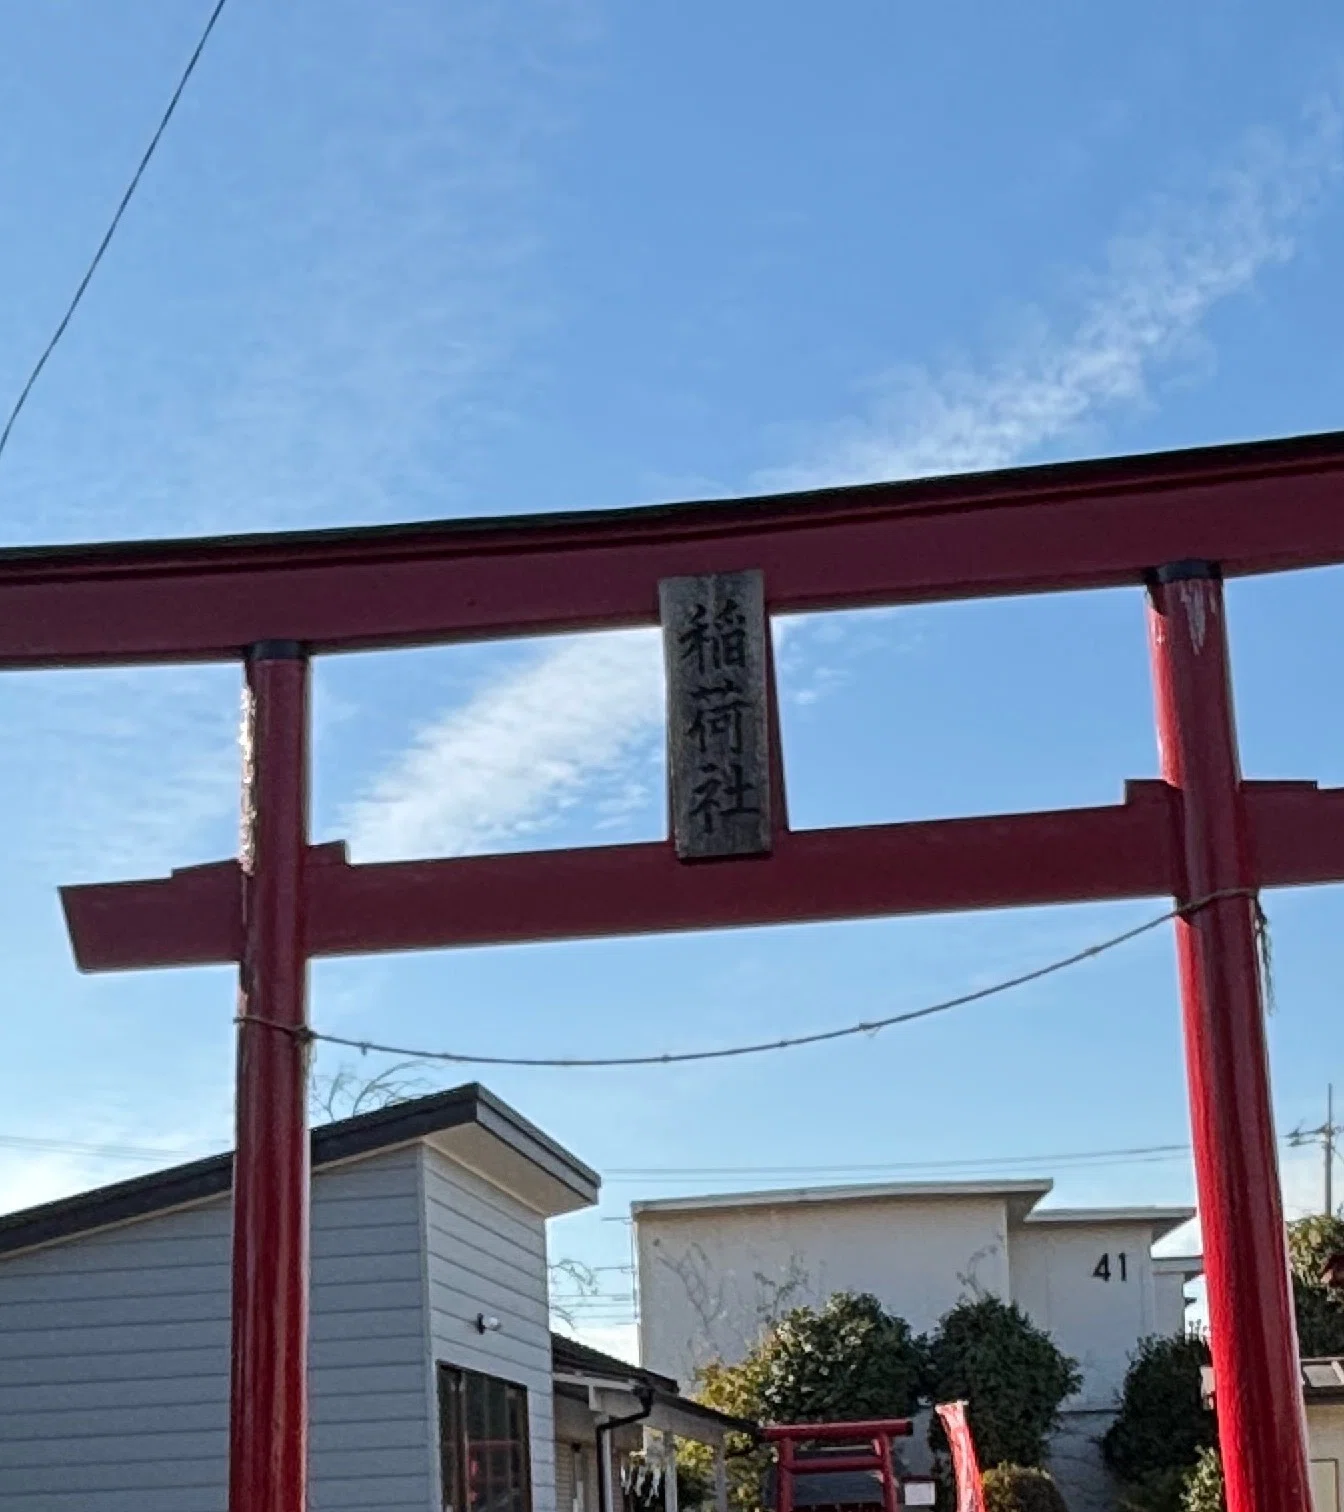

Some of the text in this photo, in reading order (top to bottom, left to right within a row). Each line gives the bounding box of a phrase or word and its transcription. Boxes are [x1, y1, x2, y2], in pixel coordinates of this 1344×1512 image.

[677, 599, 760, 834] 稲荷社
[1092, 1252, 1127, 1282] 41
